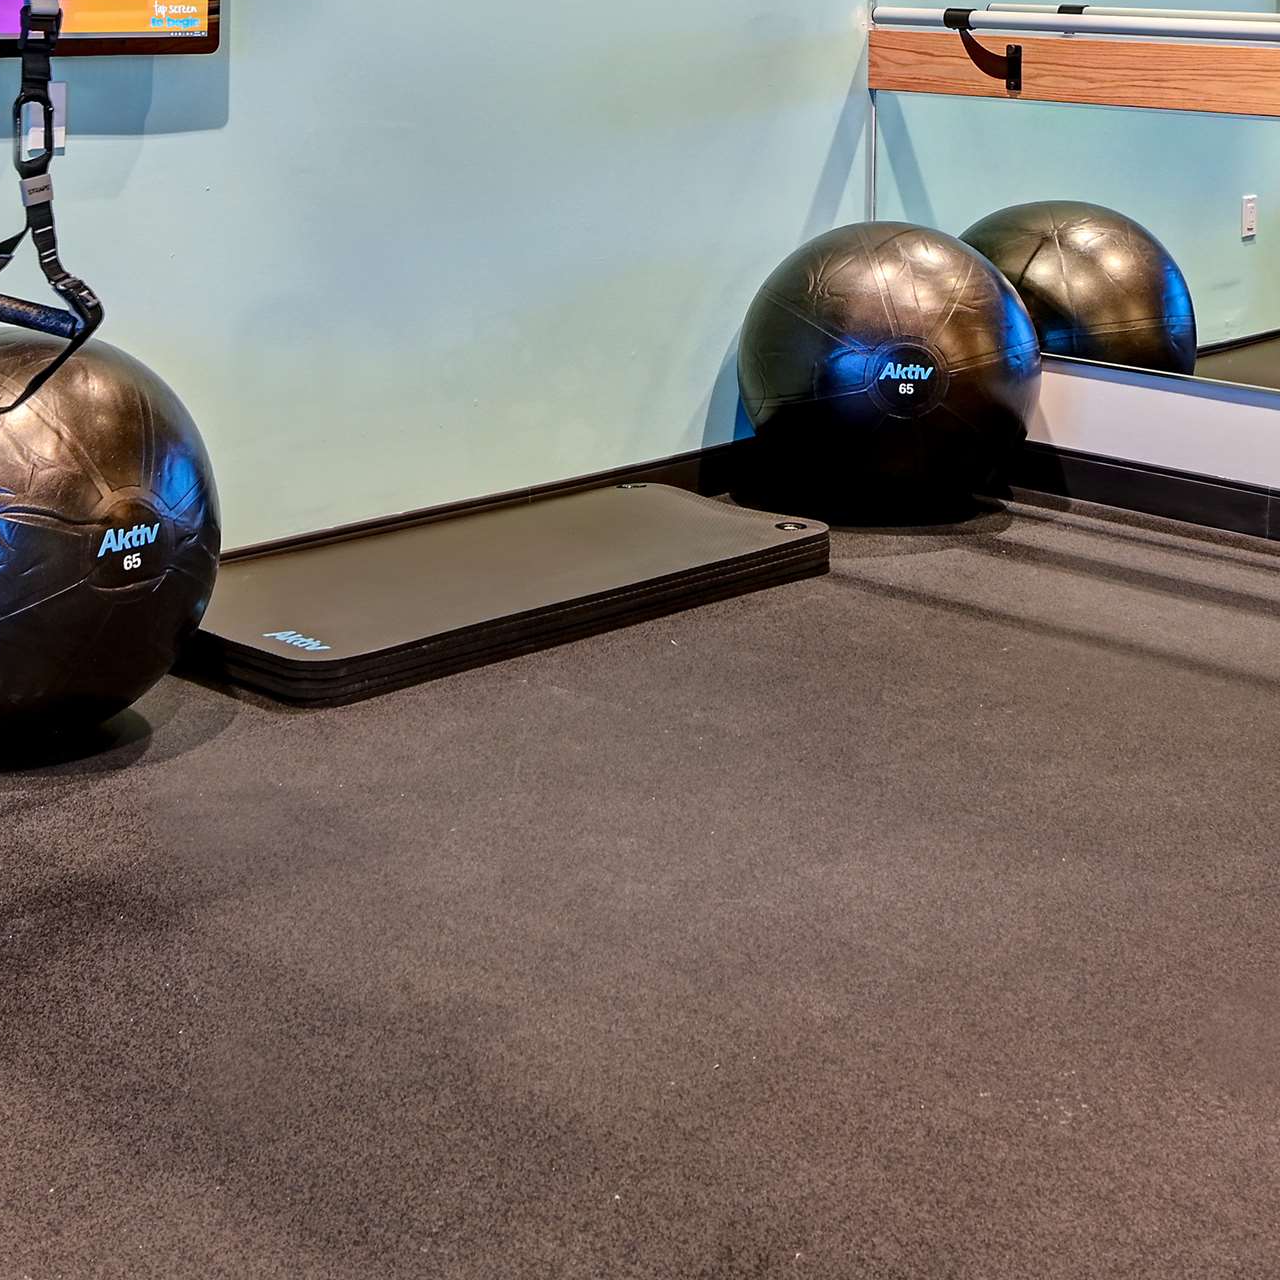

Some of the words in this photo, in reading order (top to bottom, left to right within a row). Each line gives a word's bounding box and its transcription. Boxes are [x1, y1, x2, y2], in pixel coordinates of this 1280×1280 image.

[152, 0, 168, 19] tap
[168, 4, 198, 14] screen
[879, 361, 934, 380] Aktiv
[898, 383, 915, 395] 65
[97, 522, 161, 558] Aktiv
[122, 552, 142, 571] 65
[261, 630, 332, 651] Aktiv
